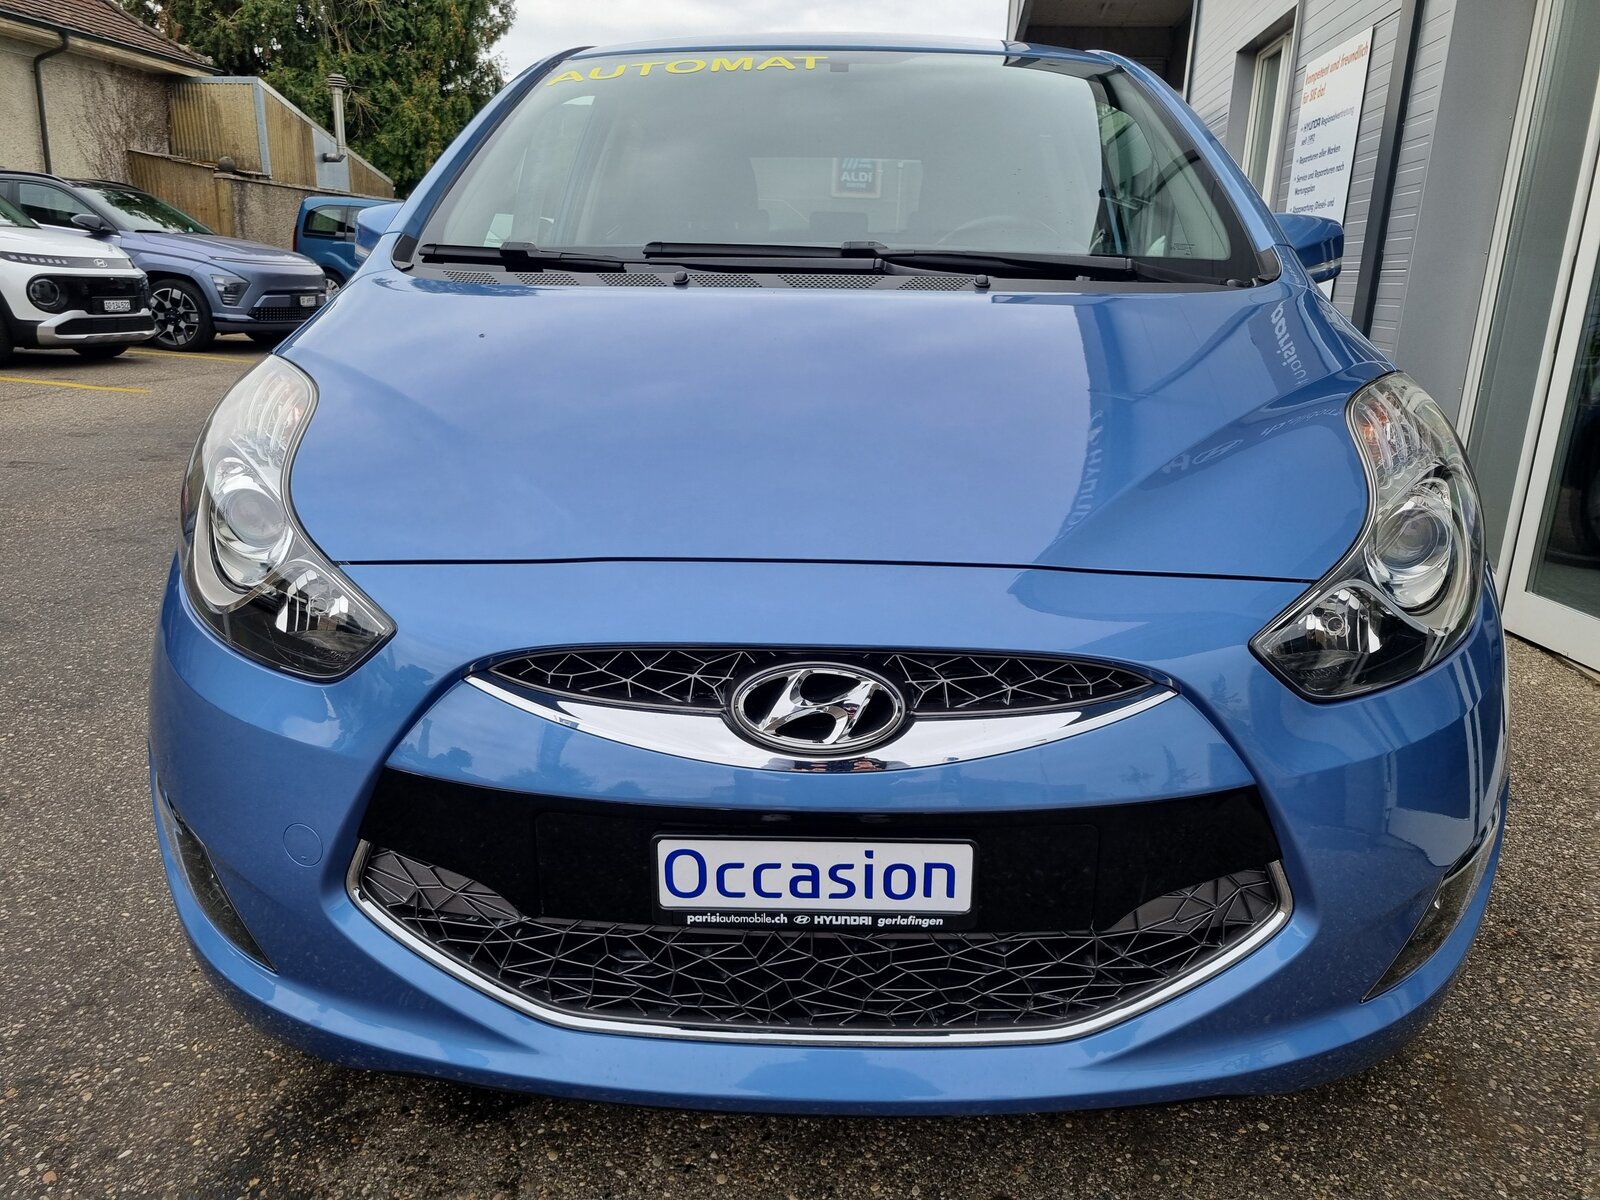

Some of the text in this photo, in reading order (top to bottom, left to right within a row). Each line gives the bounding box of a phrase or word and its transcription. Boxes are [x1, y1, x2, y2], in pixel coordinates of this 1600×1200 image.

[1329, 56, 1340, 73] und
[1340, 42, 1368, 67] freundlich
[546, 55, 828, 87] AUTOMAT
[1304, 117, 1321, 132] HYUNDAI
[1327, 144, 1341, 156] Marken
[841, 171, 872, 182] ALDI
[664, 848, 956, 900] Occasion
[687, 913, 944, 927] parisiautomobile.ch HYUNDAI gerlafingen
